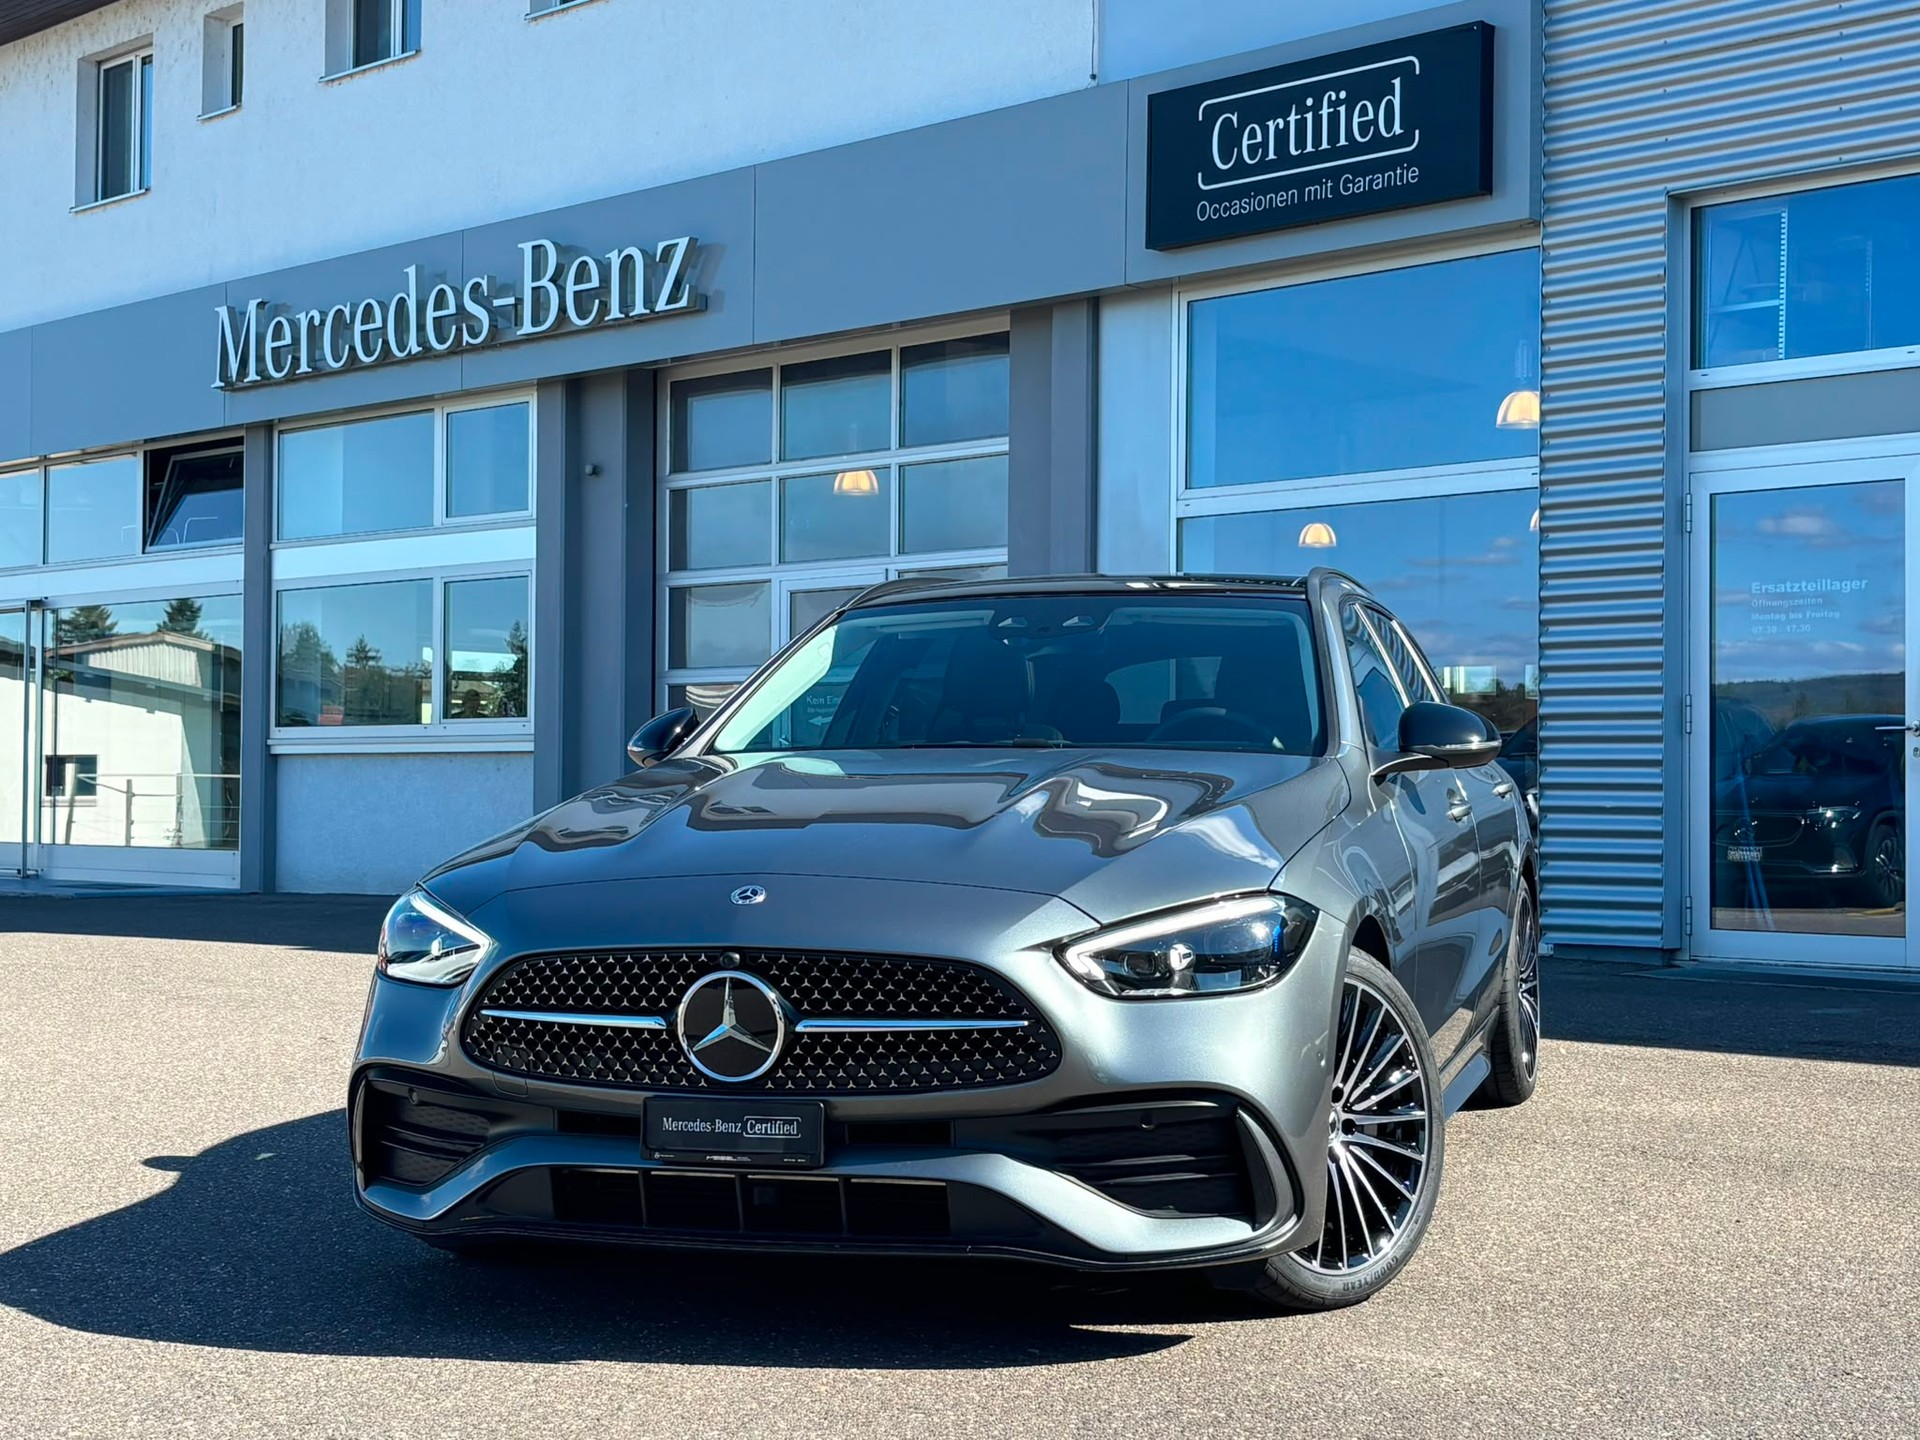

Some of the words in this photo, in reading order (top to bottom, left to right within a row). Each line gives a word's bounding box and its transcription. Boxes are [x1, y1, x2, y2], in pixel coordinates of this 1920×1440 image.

[1211, 76, 1404, 170] Certified
[1196, 188, 1298, 222] Occasionen
[1304, 178, 1334, 202] mit
[1339, 163, 1420, 196] Garantie
[211, 236, 698, 389] Mercedes-Benz
[1751, 578, 1868, 594] Ersatzteillager
[662, 1116, 742, 1133] Mercedes-Benz
[747, 1119, 798, 1135] Certified
